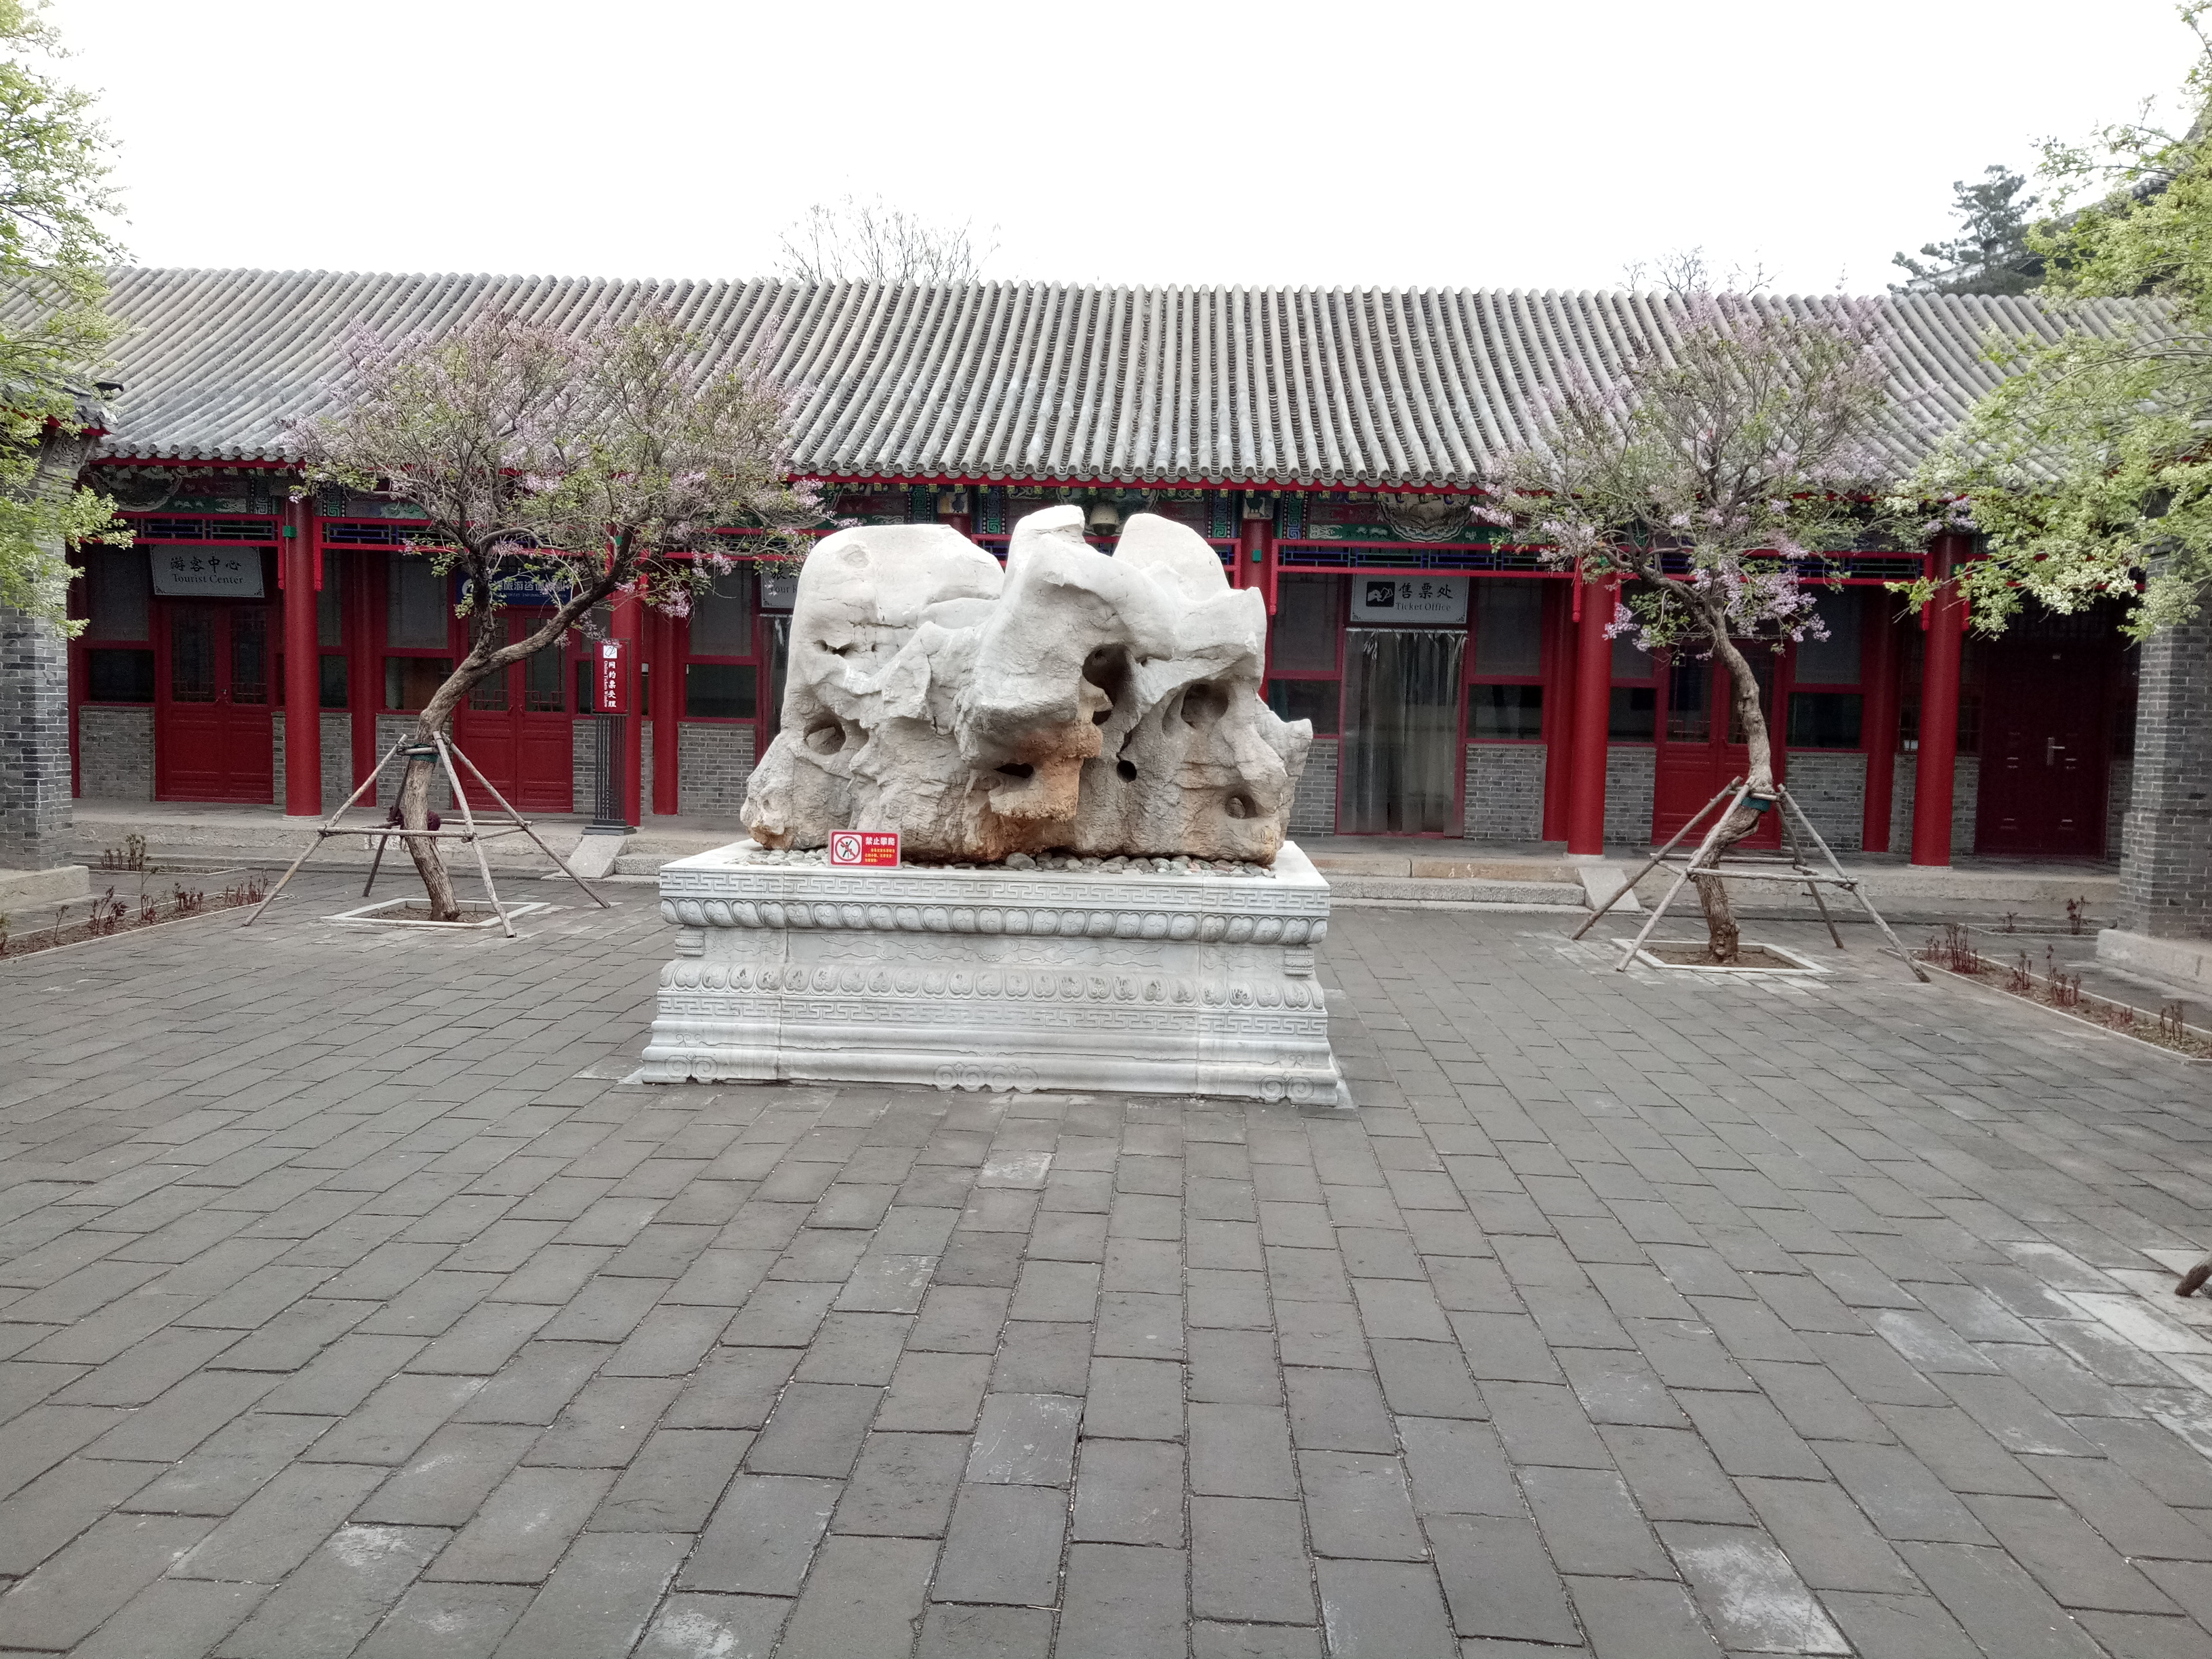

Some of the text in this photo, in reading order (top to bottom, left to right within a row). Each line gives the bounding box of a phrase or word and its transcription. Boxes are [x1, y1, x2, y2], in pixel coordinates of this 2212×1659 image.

[171, 556, 241, 573] 游客中心
[172, 574, 243, 584] Tourist Center
[1399, 582, 1453, 599] 售票处
[1395, 602, 1451, 611] Ticket Office
